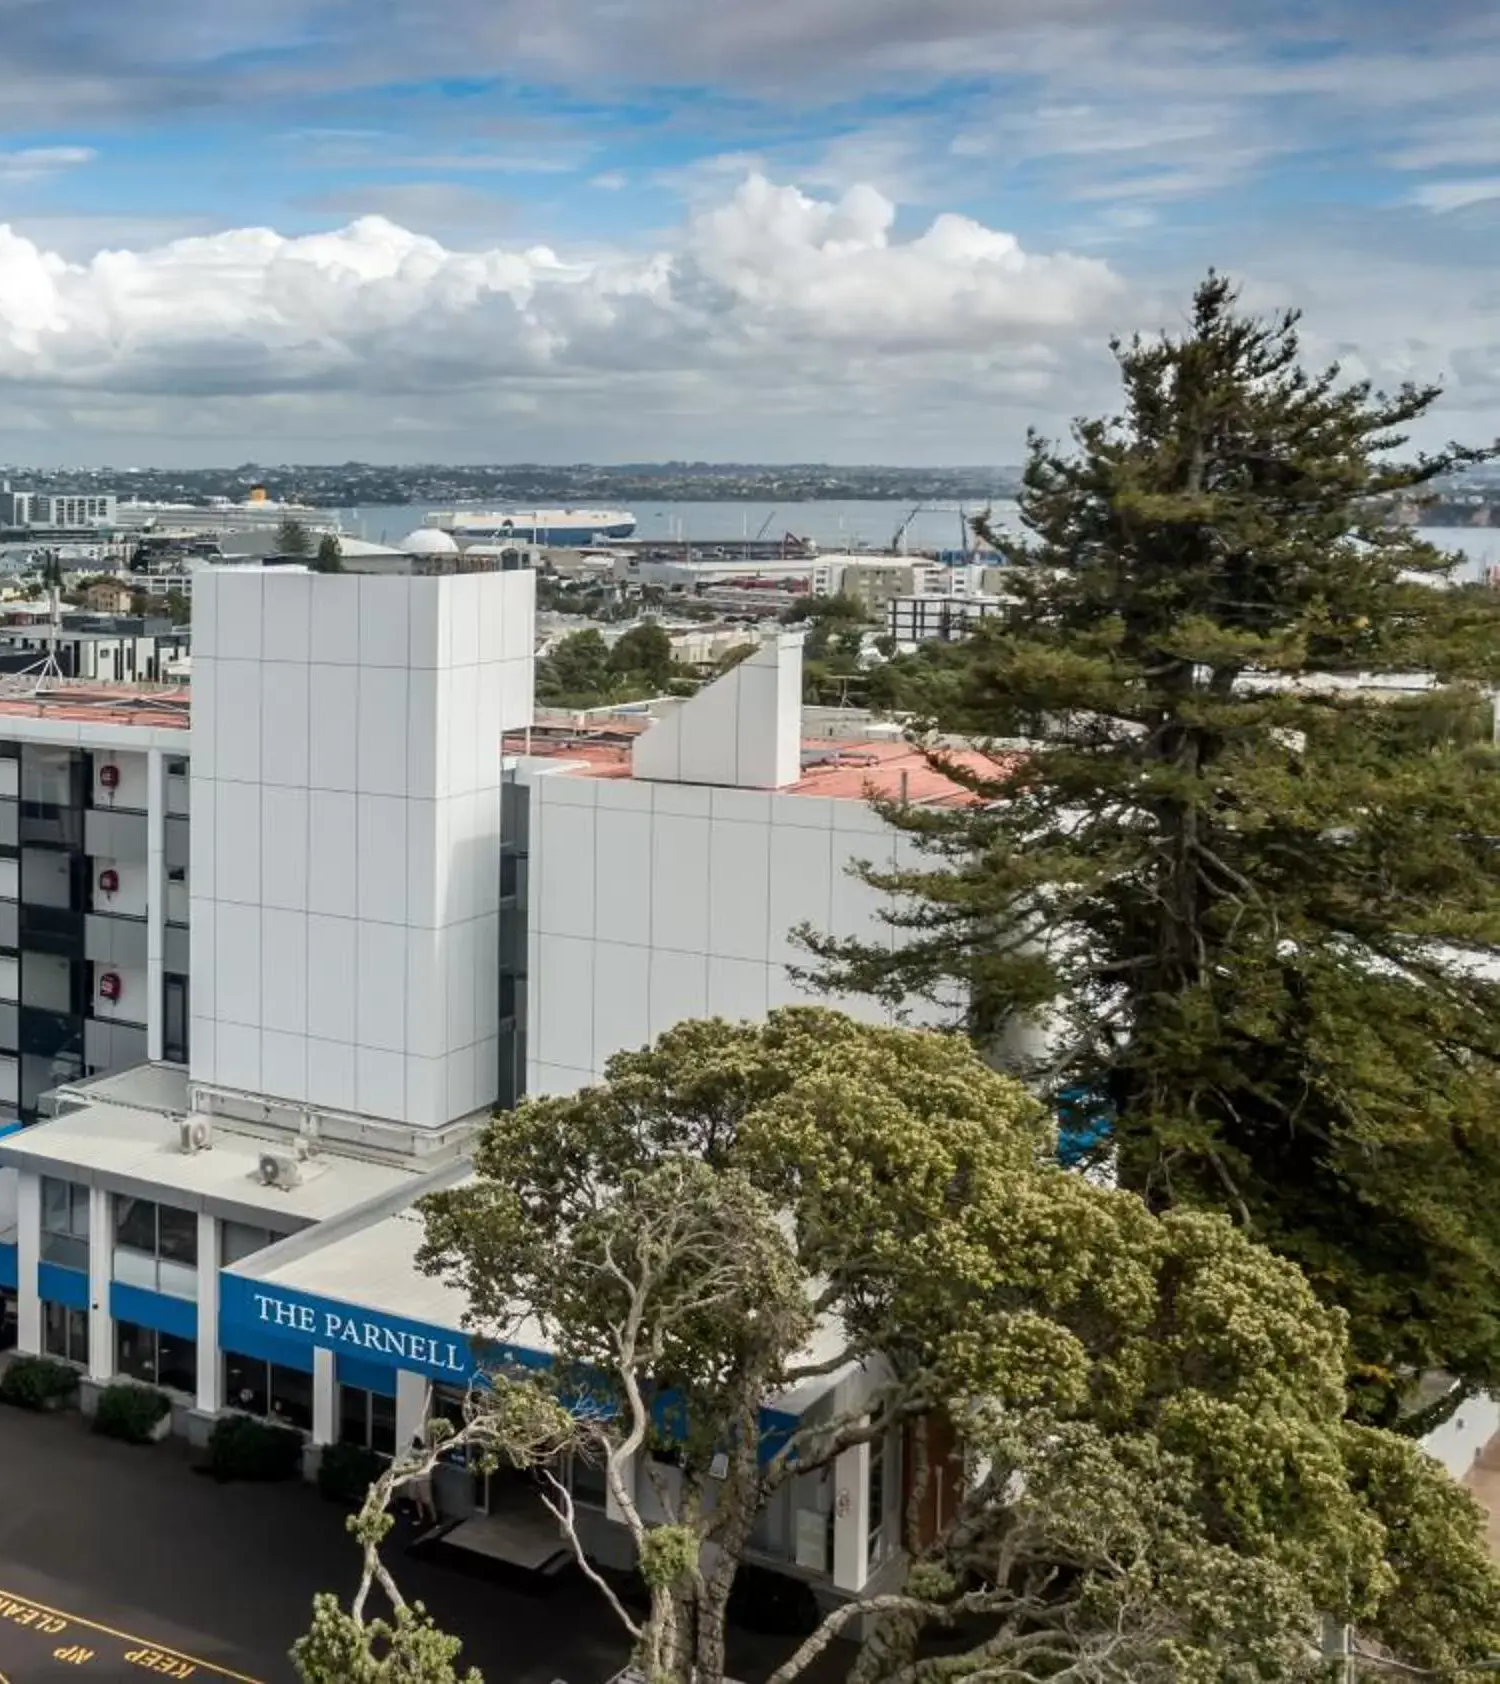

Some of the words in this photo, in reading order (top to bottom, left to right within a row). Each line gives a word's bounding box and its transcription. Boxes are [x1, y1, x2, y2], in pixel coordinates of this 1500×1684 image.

[255, 1295, 316, 1332] THE
[325, 1313, 465, 1372] PARNELL
[124, 1648, 196, 1680] KEEP
